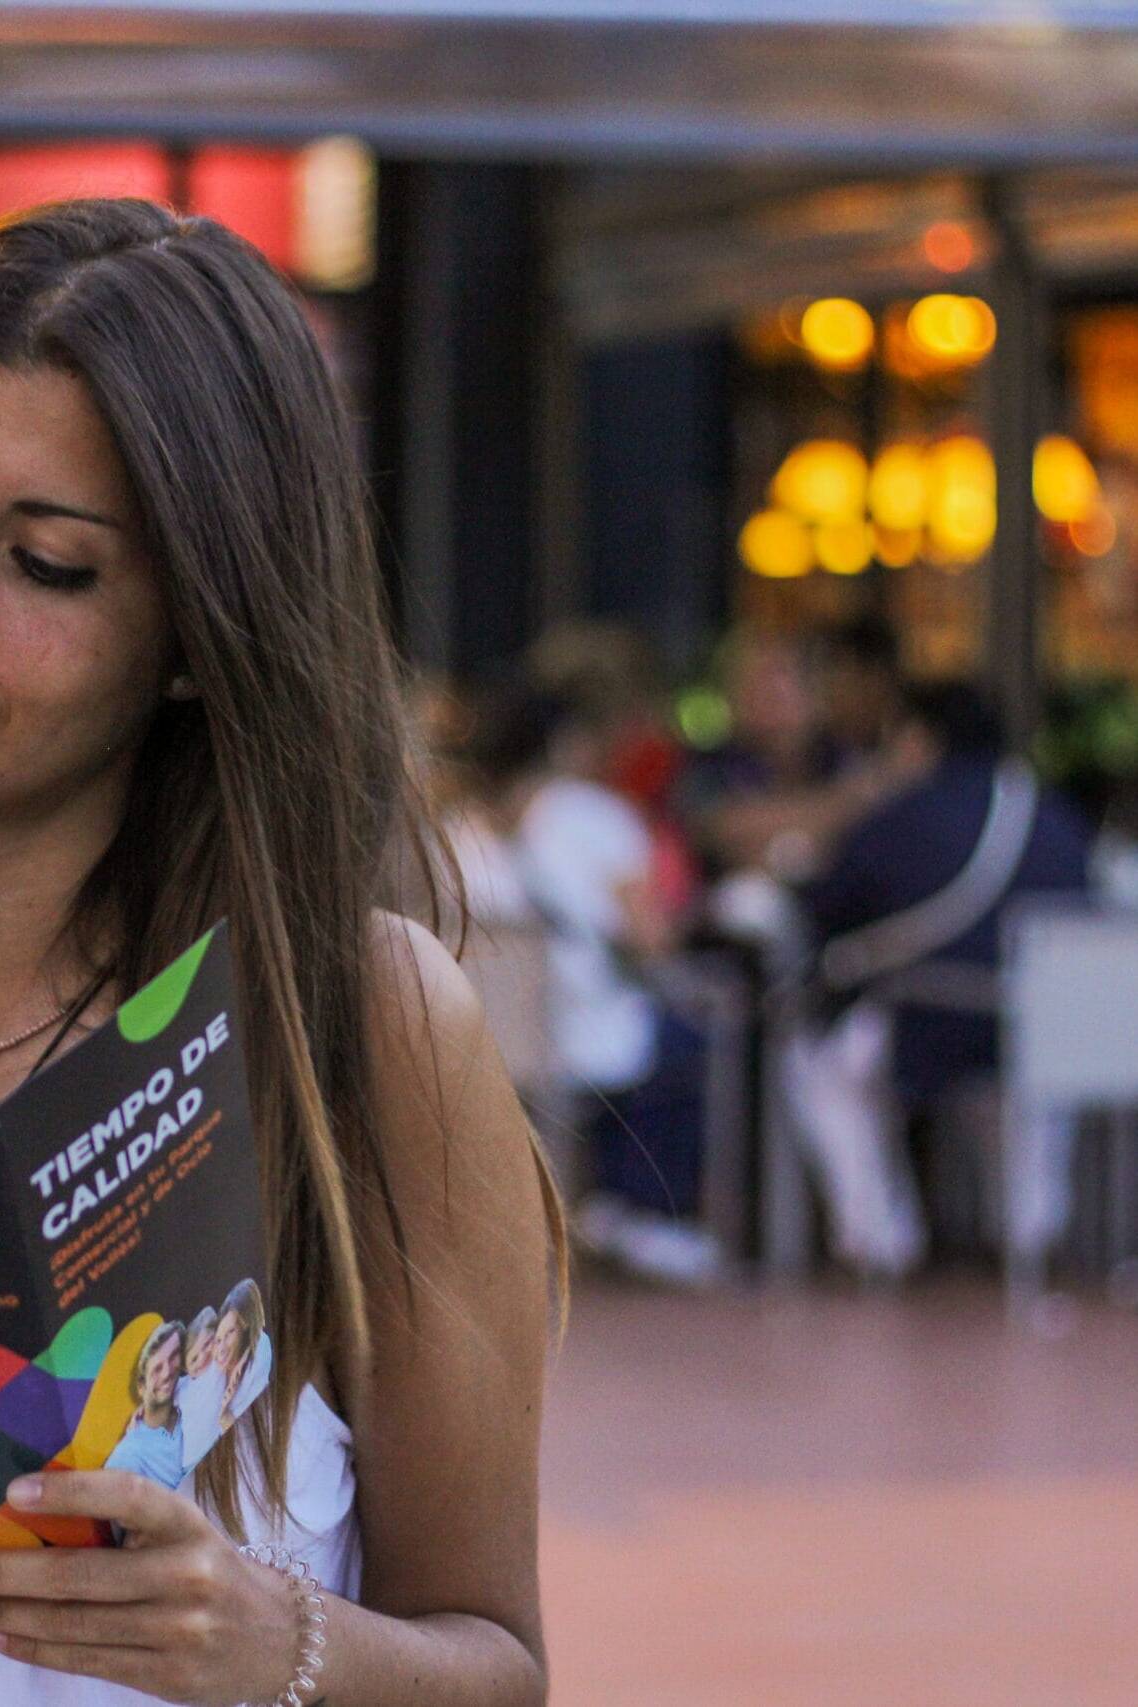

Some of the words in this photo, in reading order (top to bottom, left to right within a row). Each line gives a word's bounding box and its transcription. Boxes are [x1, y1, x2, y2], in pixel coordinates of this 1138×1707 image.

[30, 1067, 174, 1198] TIEMPO
[181, 1011, 229, 1076] DE
[42, 1087, 203, 1239] CALIDAD
